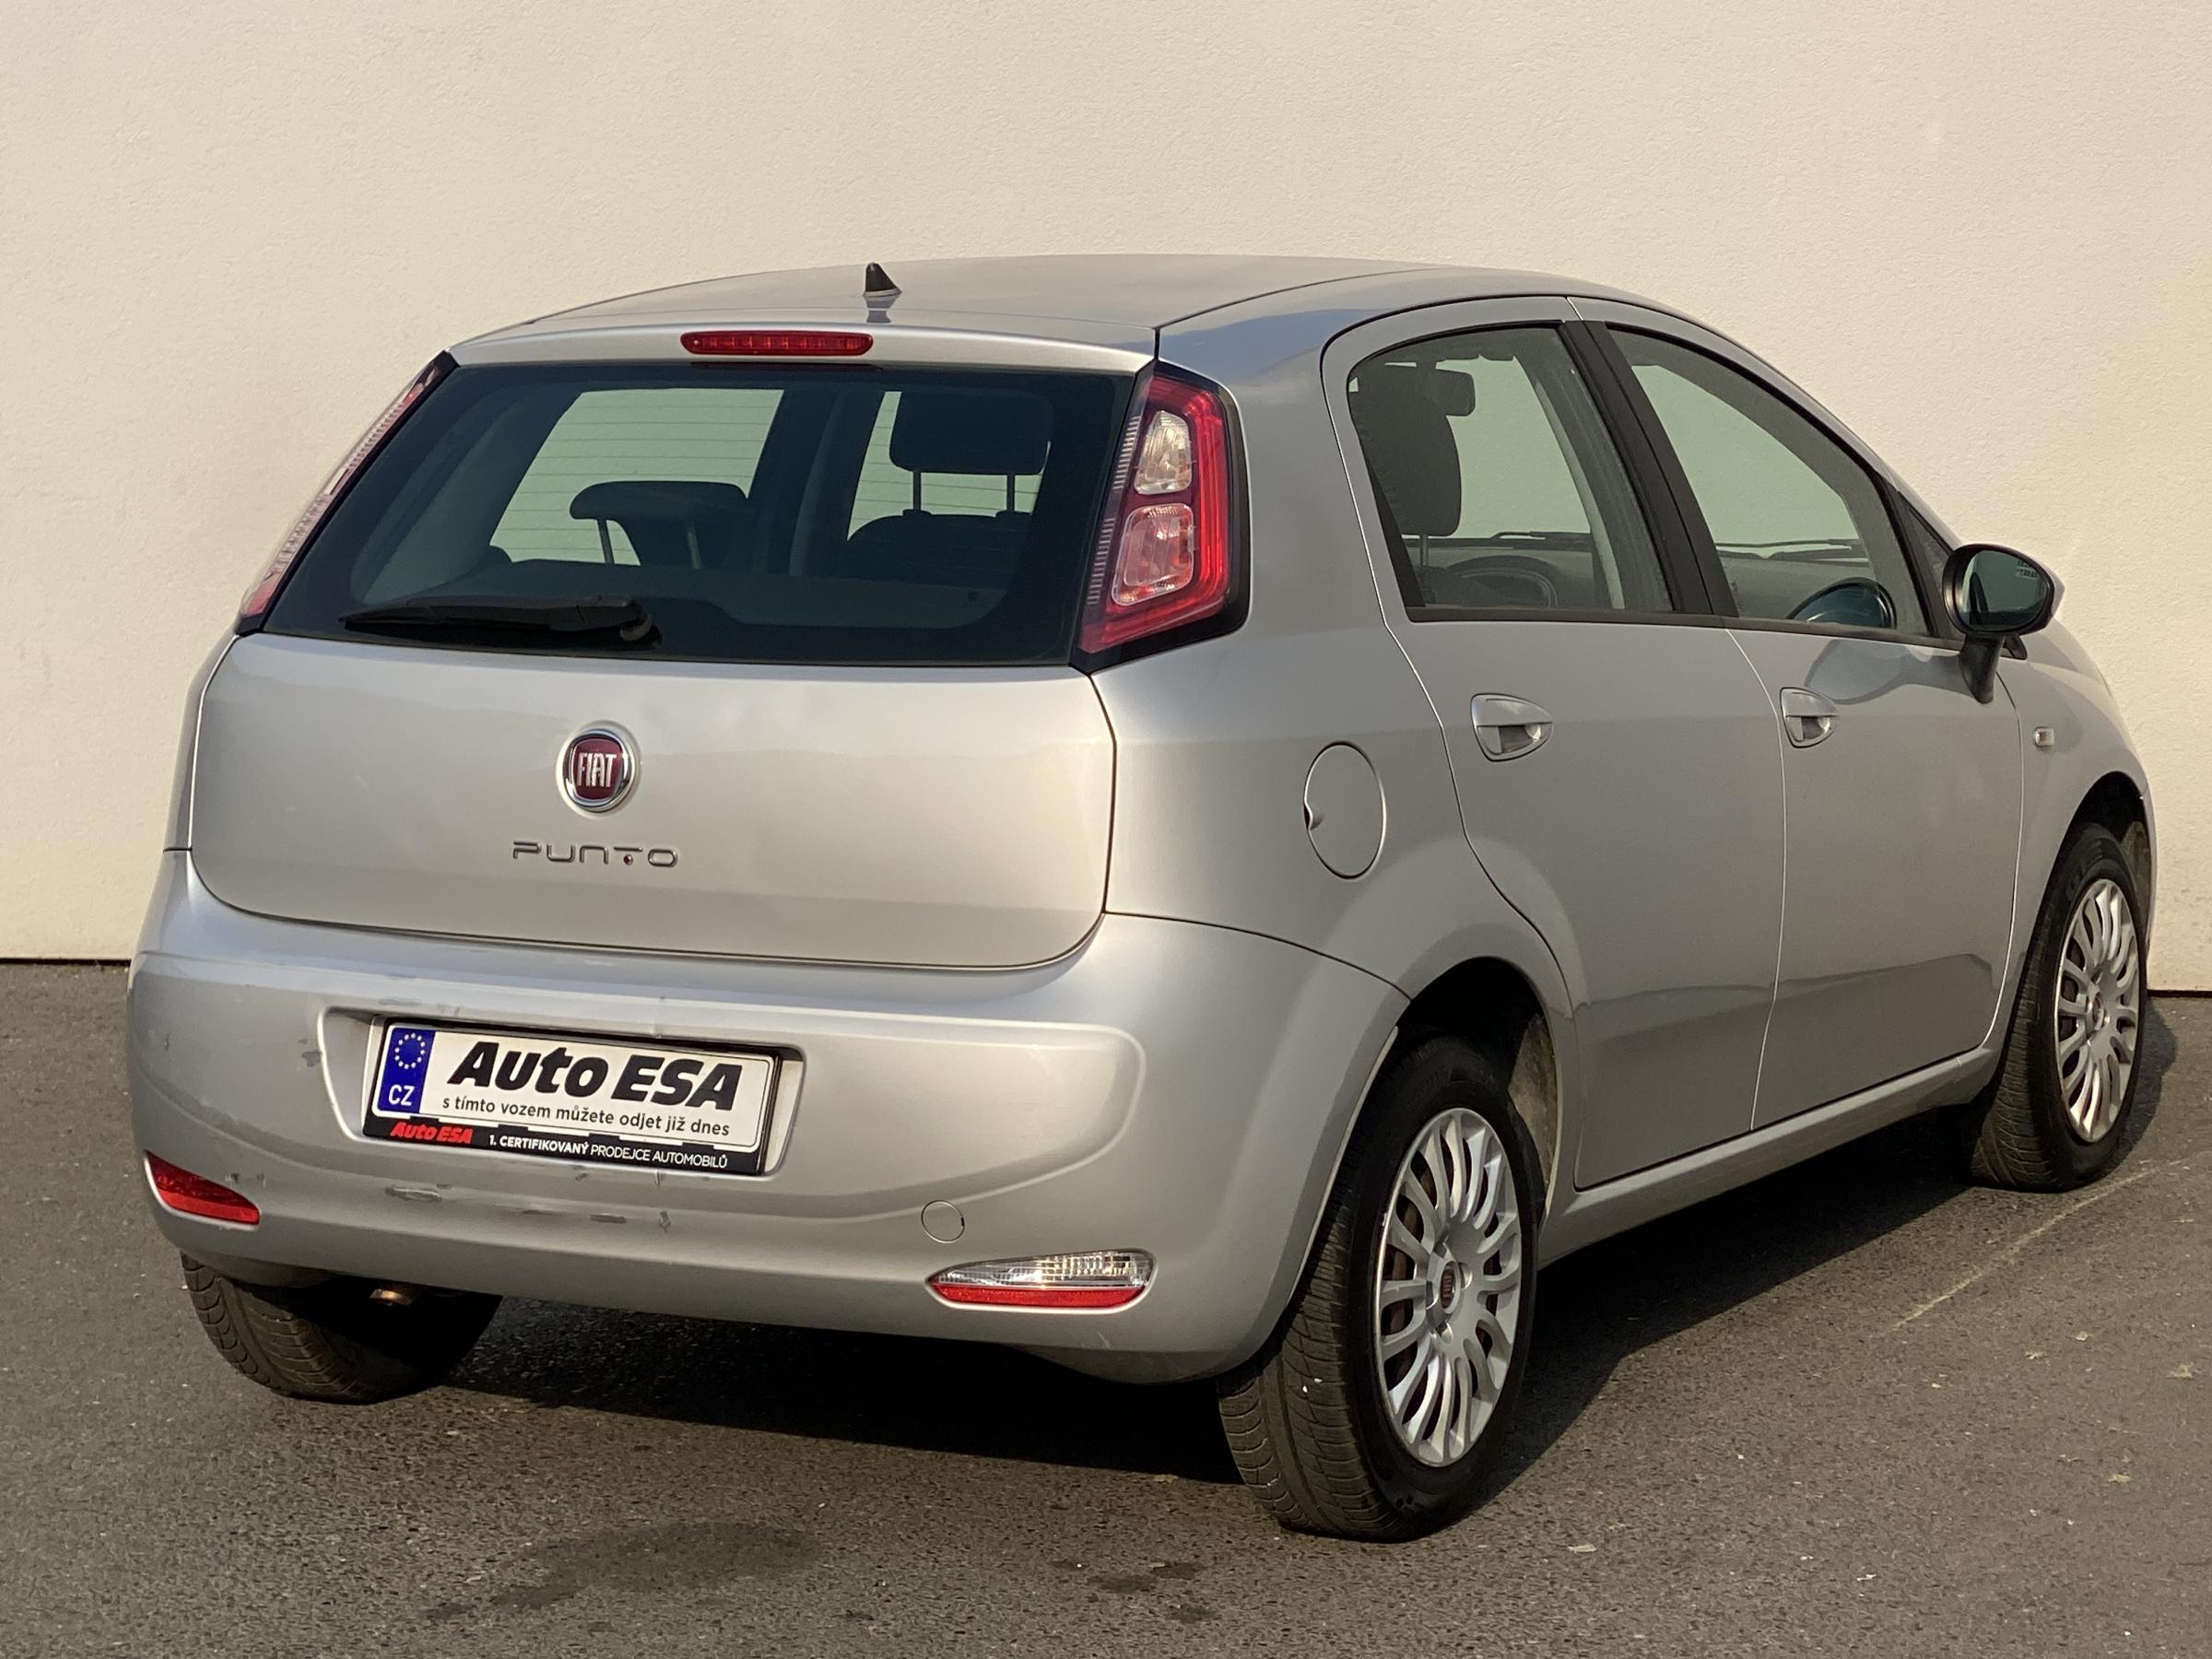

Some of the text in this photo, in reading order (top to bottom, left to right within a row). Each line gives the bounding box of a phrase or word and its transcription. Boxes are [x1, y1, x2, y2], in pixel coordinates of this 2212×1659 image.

[576, 752, 618, 788] FIAT
[512, 840, 679, 868] PUNTO
[446, 1041, 743, 1112] Auto ESA
[388, 1084, 415, 1107] CZ
[390, 1121, 473, 1144] Auto ESA
[442, 1095, 730, 1136] s tímto vozem můžete odjet již dnes
[488, 1135, 728, 1169] 1. CERTIFIKOVANÝ PRODEJCE AUTOMOBILŮ
